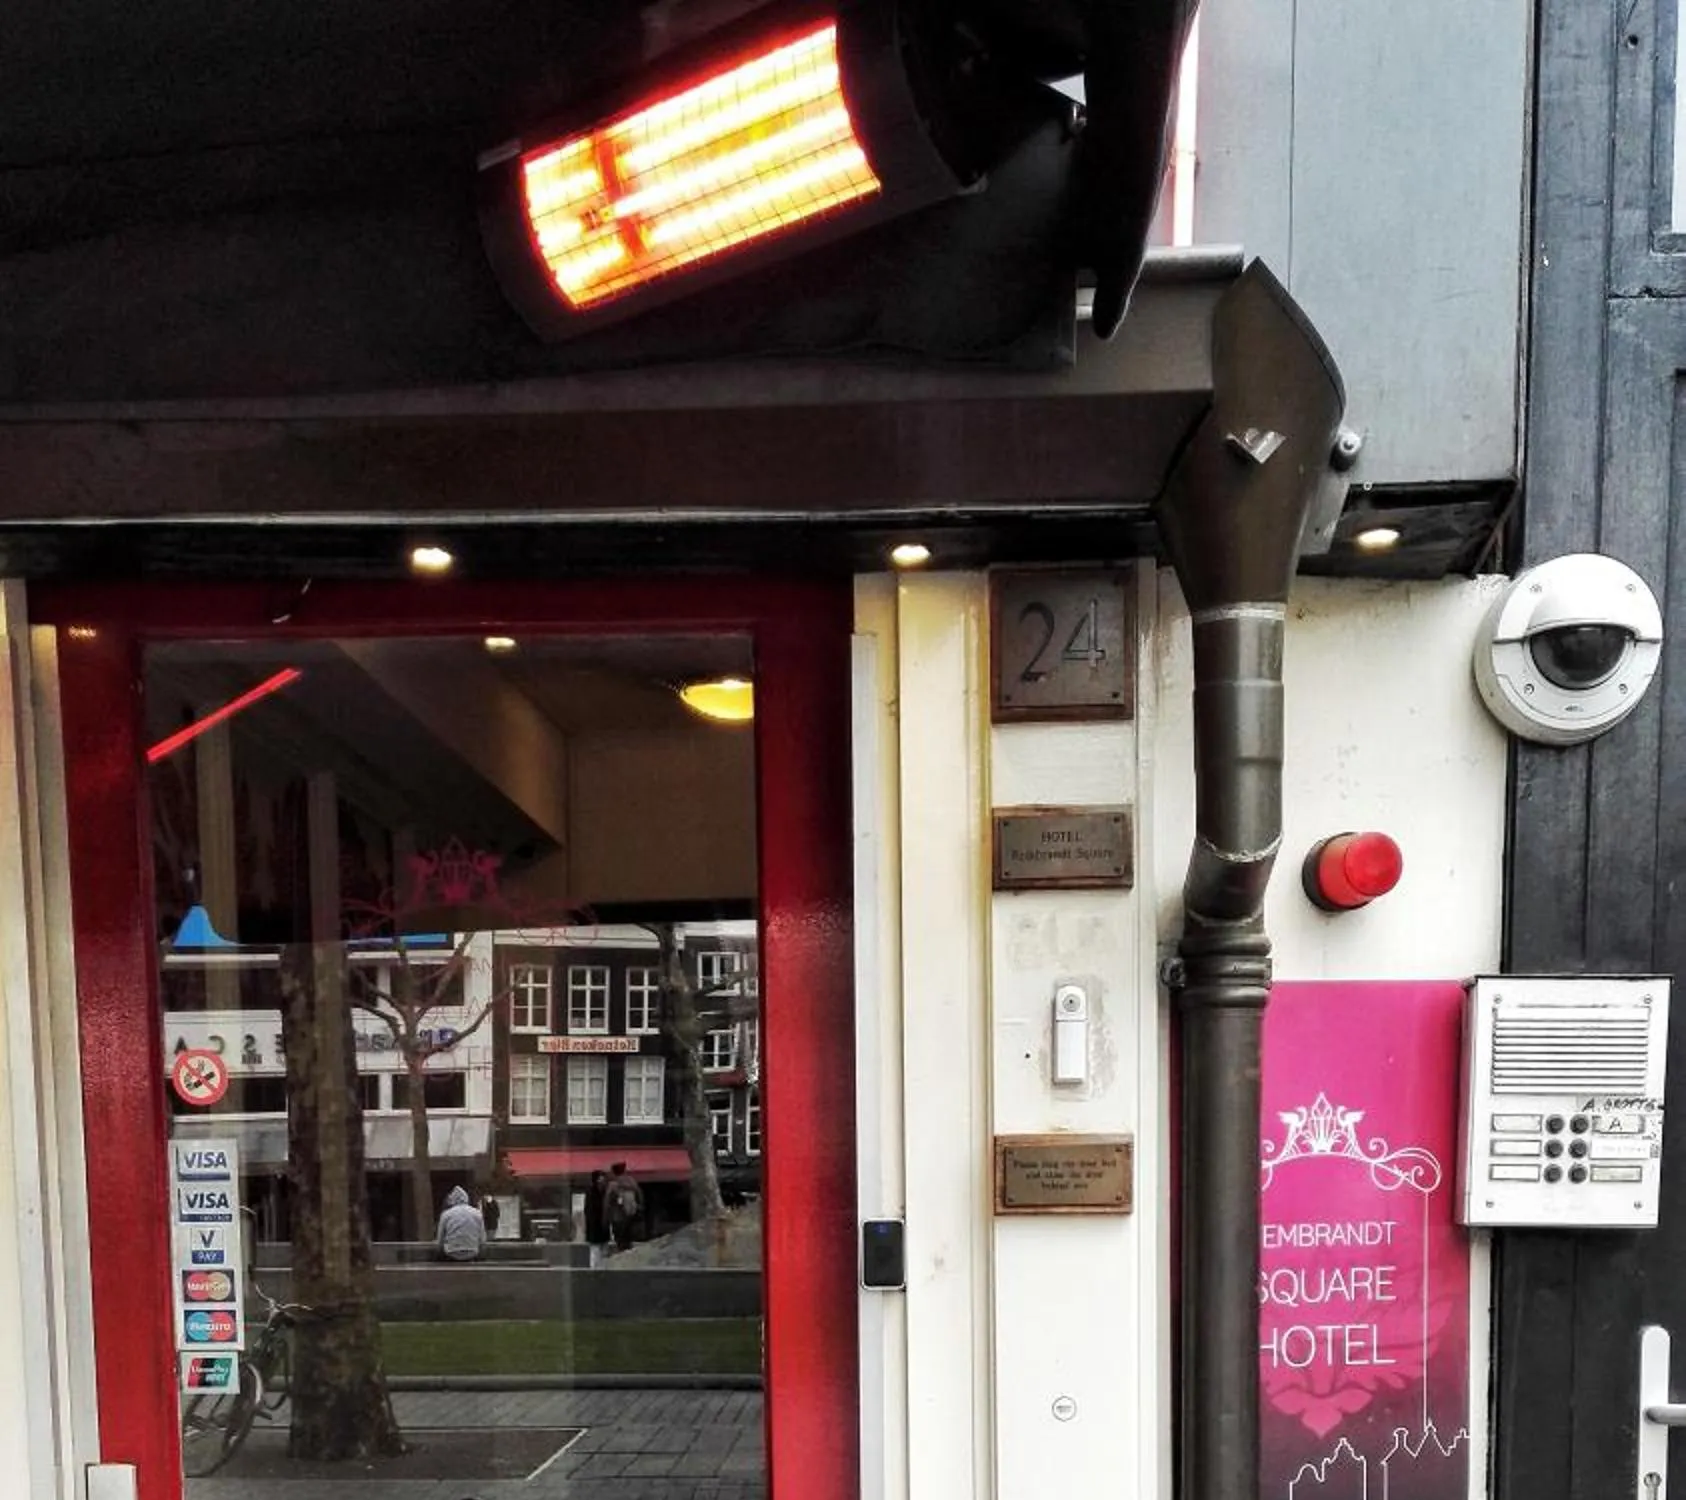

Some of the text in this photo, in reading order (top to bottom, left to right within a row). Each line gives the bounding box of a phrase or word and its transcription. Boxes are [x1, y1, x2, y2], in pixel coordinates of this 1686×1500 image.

[1019, 599, 1106, 682] 24
[1041, 831, 1082, 842] HOTEL
[184, 1151, 227, 1168] VISA
[186, 1193, 229, 1208] VISA
[200, 1230, 215, 1248] V
[1262, 1221, 1397, 1248] EMBRANDT
